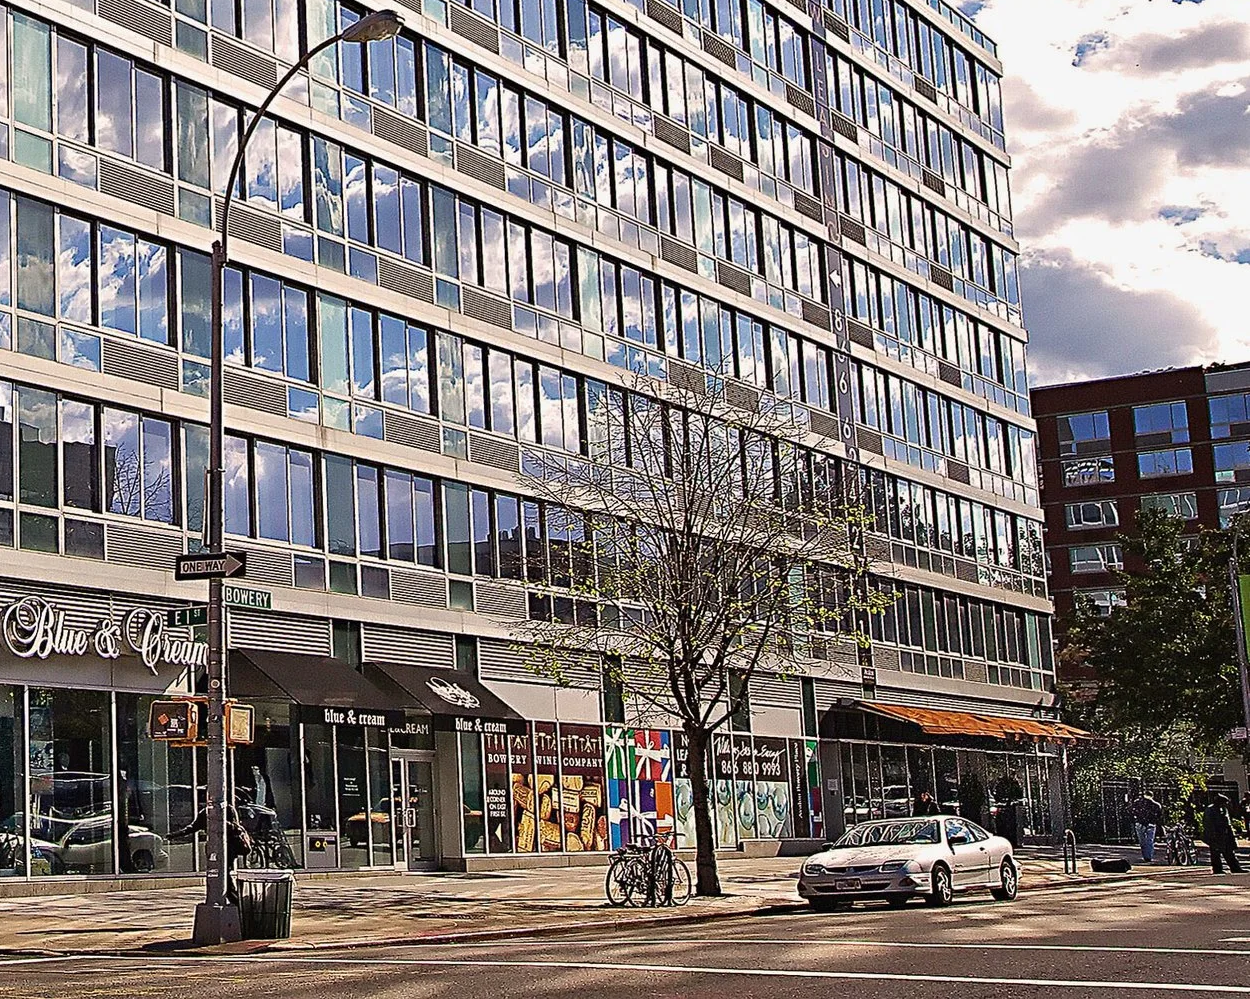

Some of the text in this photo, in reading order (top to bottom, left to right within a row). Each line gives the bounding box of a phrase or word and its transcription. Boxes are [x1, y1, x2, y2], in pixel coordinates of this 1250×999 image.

[182, 560, 225, 574] ONE WAY
[225, 587, 270, 608] BOWERY
[175, 610, 181, 625] E
[2, 595, 210, 676] Blue & Cream
[324, 708, 386, 726] blue & cream
[454, 717, 507, 733] blue & cream
[487, 753, 603, 768] BOWERY WINE COMPANY
[721, 760, 781, 776] 866 880 9993
